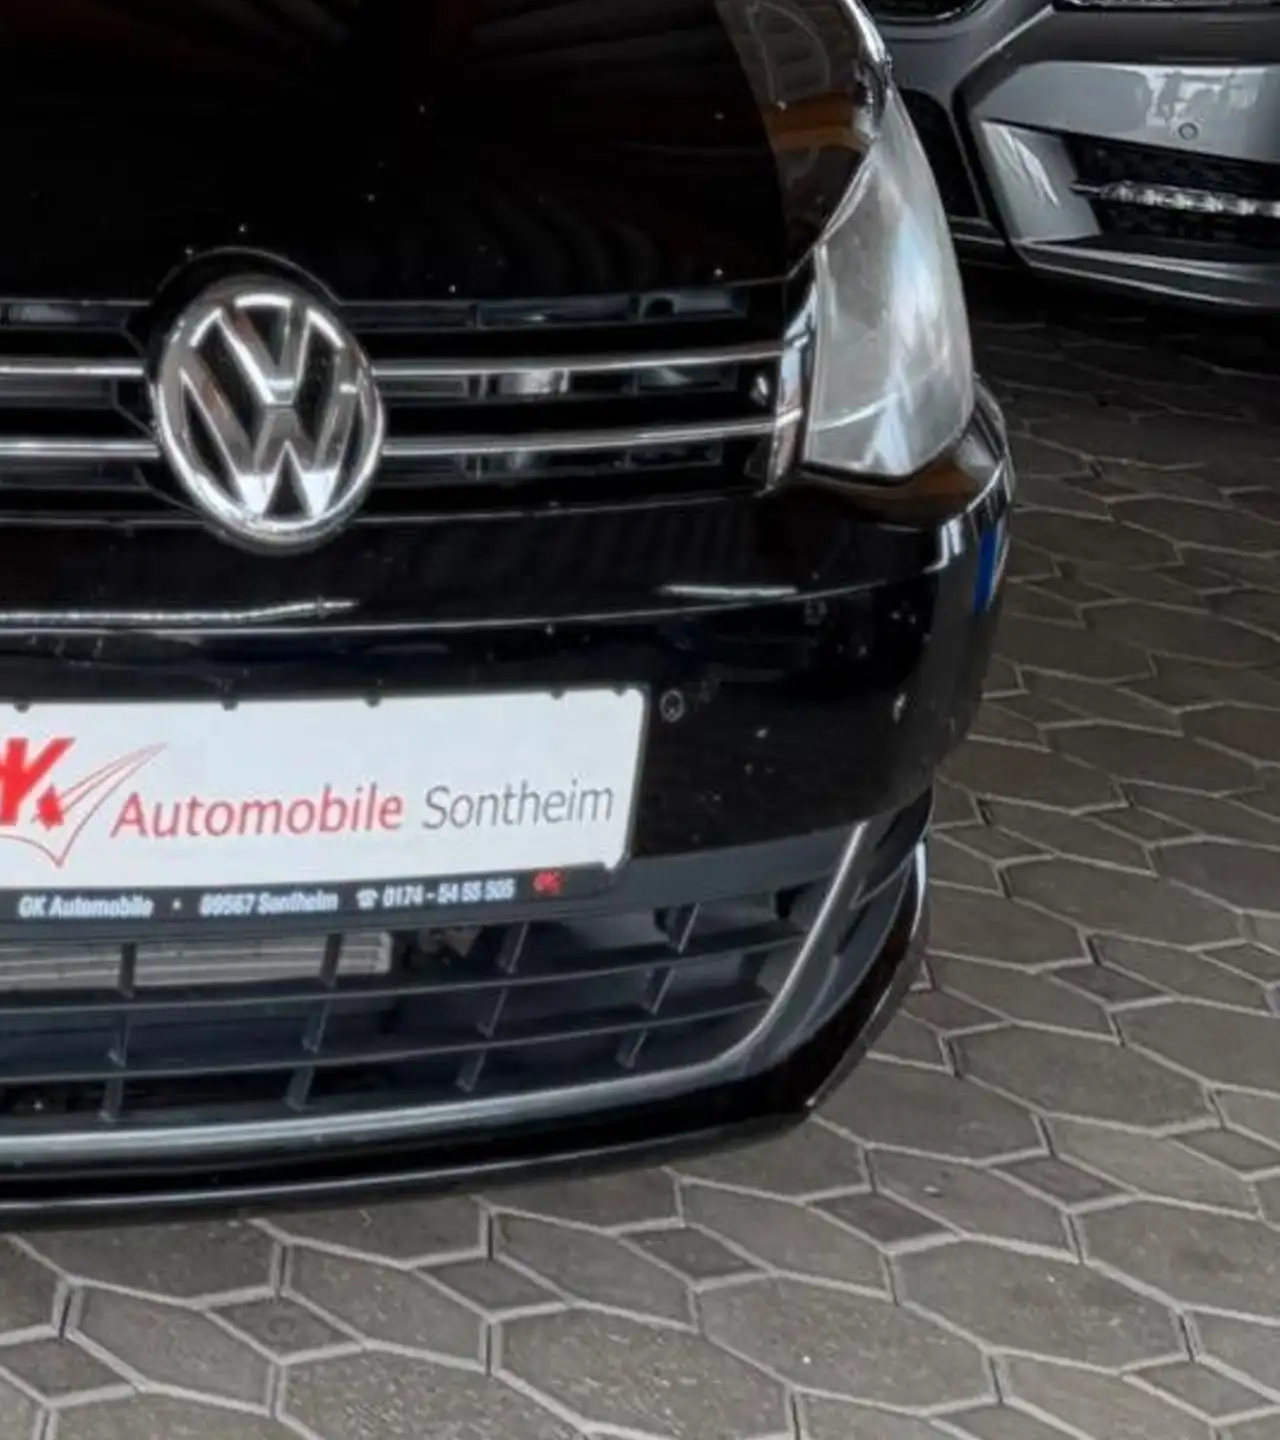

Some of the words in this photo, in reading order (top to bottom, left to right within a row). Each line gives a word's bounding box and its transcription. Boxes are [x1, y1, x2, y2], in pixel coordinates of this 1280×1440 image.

[176, 296, 366, 526] VW
[109, 782, 405, 839] Automobile
[422, 777, 614, 831] Sontheim
[48, 893, 154, 919] Automobile
[257, 889, 339, 915] Sontheim
[382, 883, 424, 908] 0174
